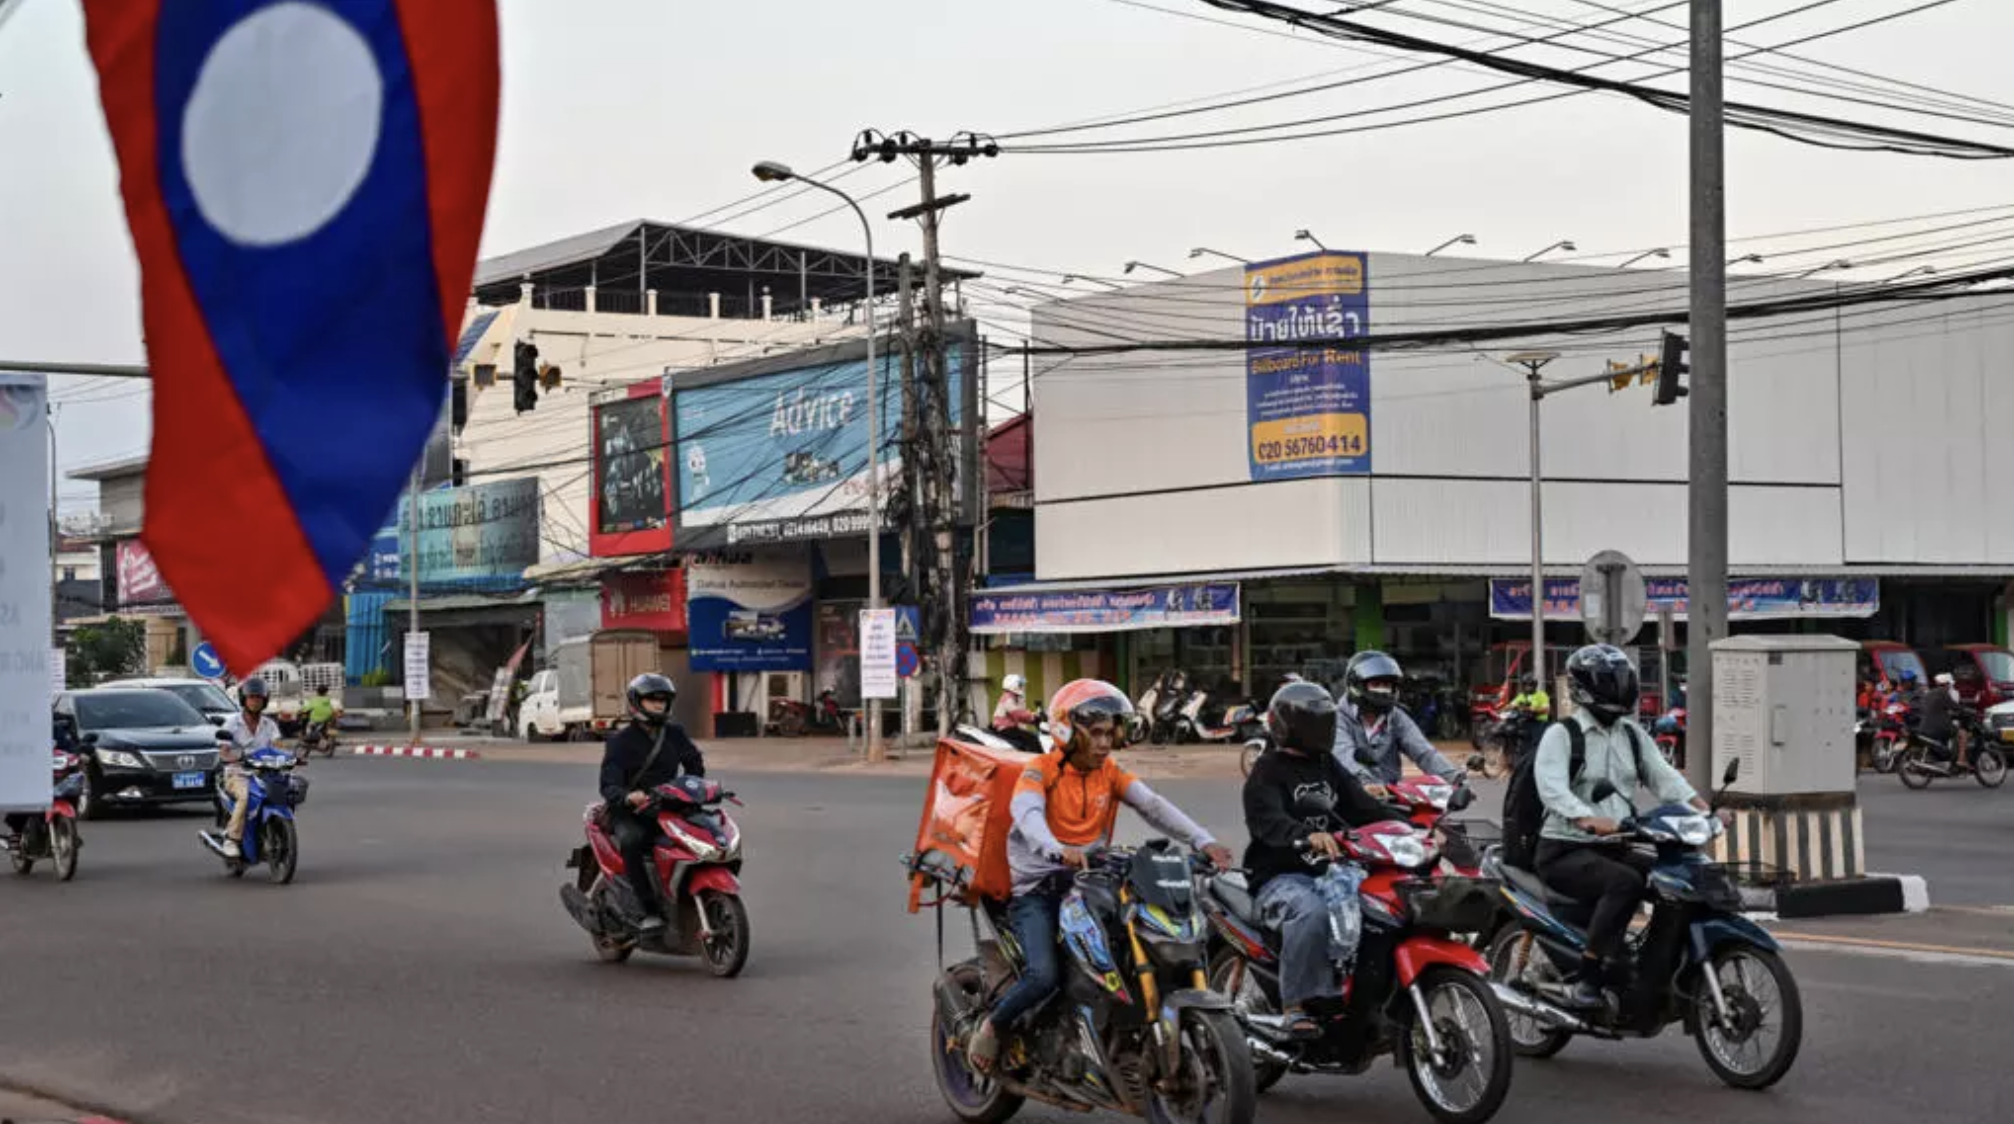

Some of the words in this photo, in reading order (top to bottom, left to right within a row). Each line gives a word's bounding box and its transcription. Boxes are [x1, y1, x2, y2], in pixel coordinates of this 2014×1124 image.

[1302, 353, 1319, 366] For
[1324, 349, 1361, 365] Rent
[769, 386, 853, 437] Advice
[1285, 434, 1361, 456] 56760414
